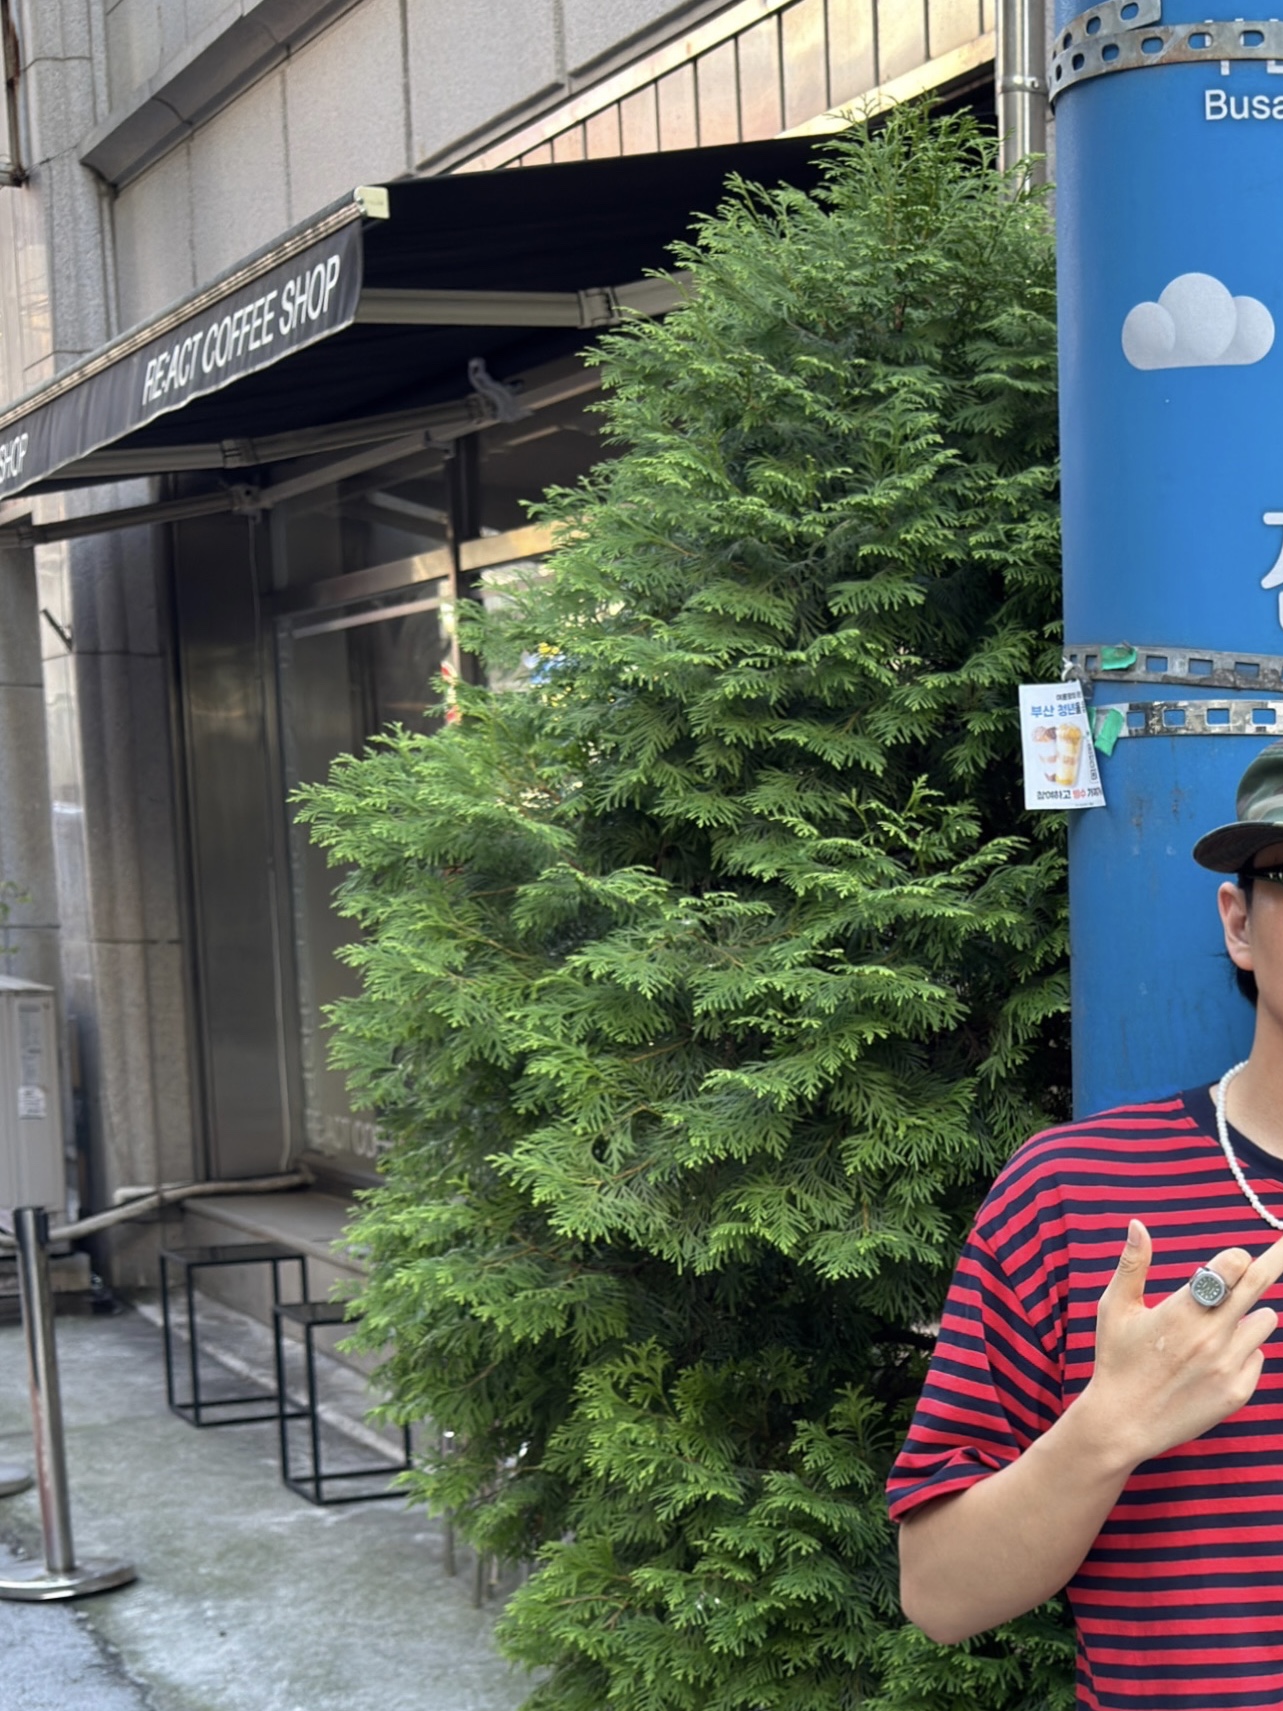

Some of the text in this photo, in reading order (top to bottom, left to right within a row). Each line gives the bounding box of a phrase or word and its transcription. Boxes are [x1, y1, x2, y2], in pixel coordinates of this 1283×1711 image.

[201, 290, 278, 374] COFFEE
[278, 254, 341, 336] SHOP
[1031, 705, 1055, 718] 부산
